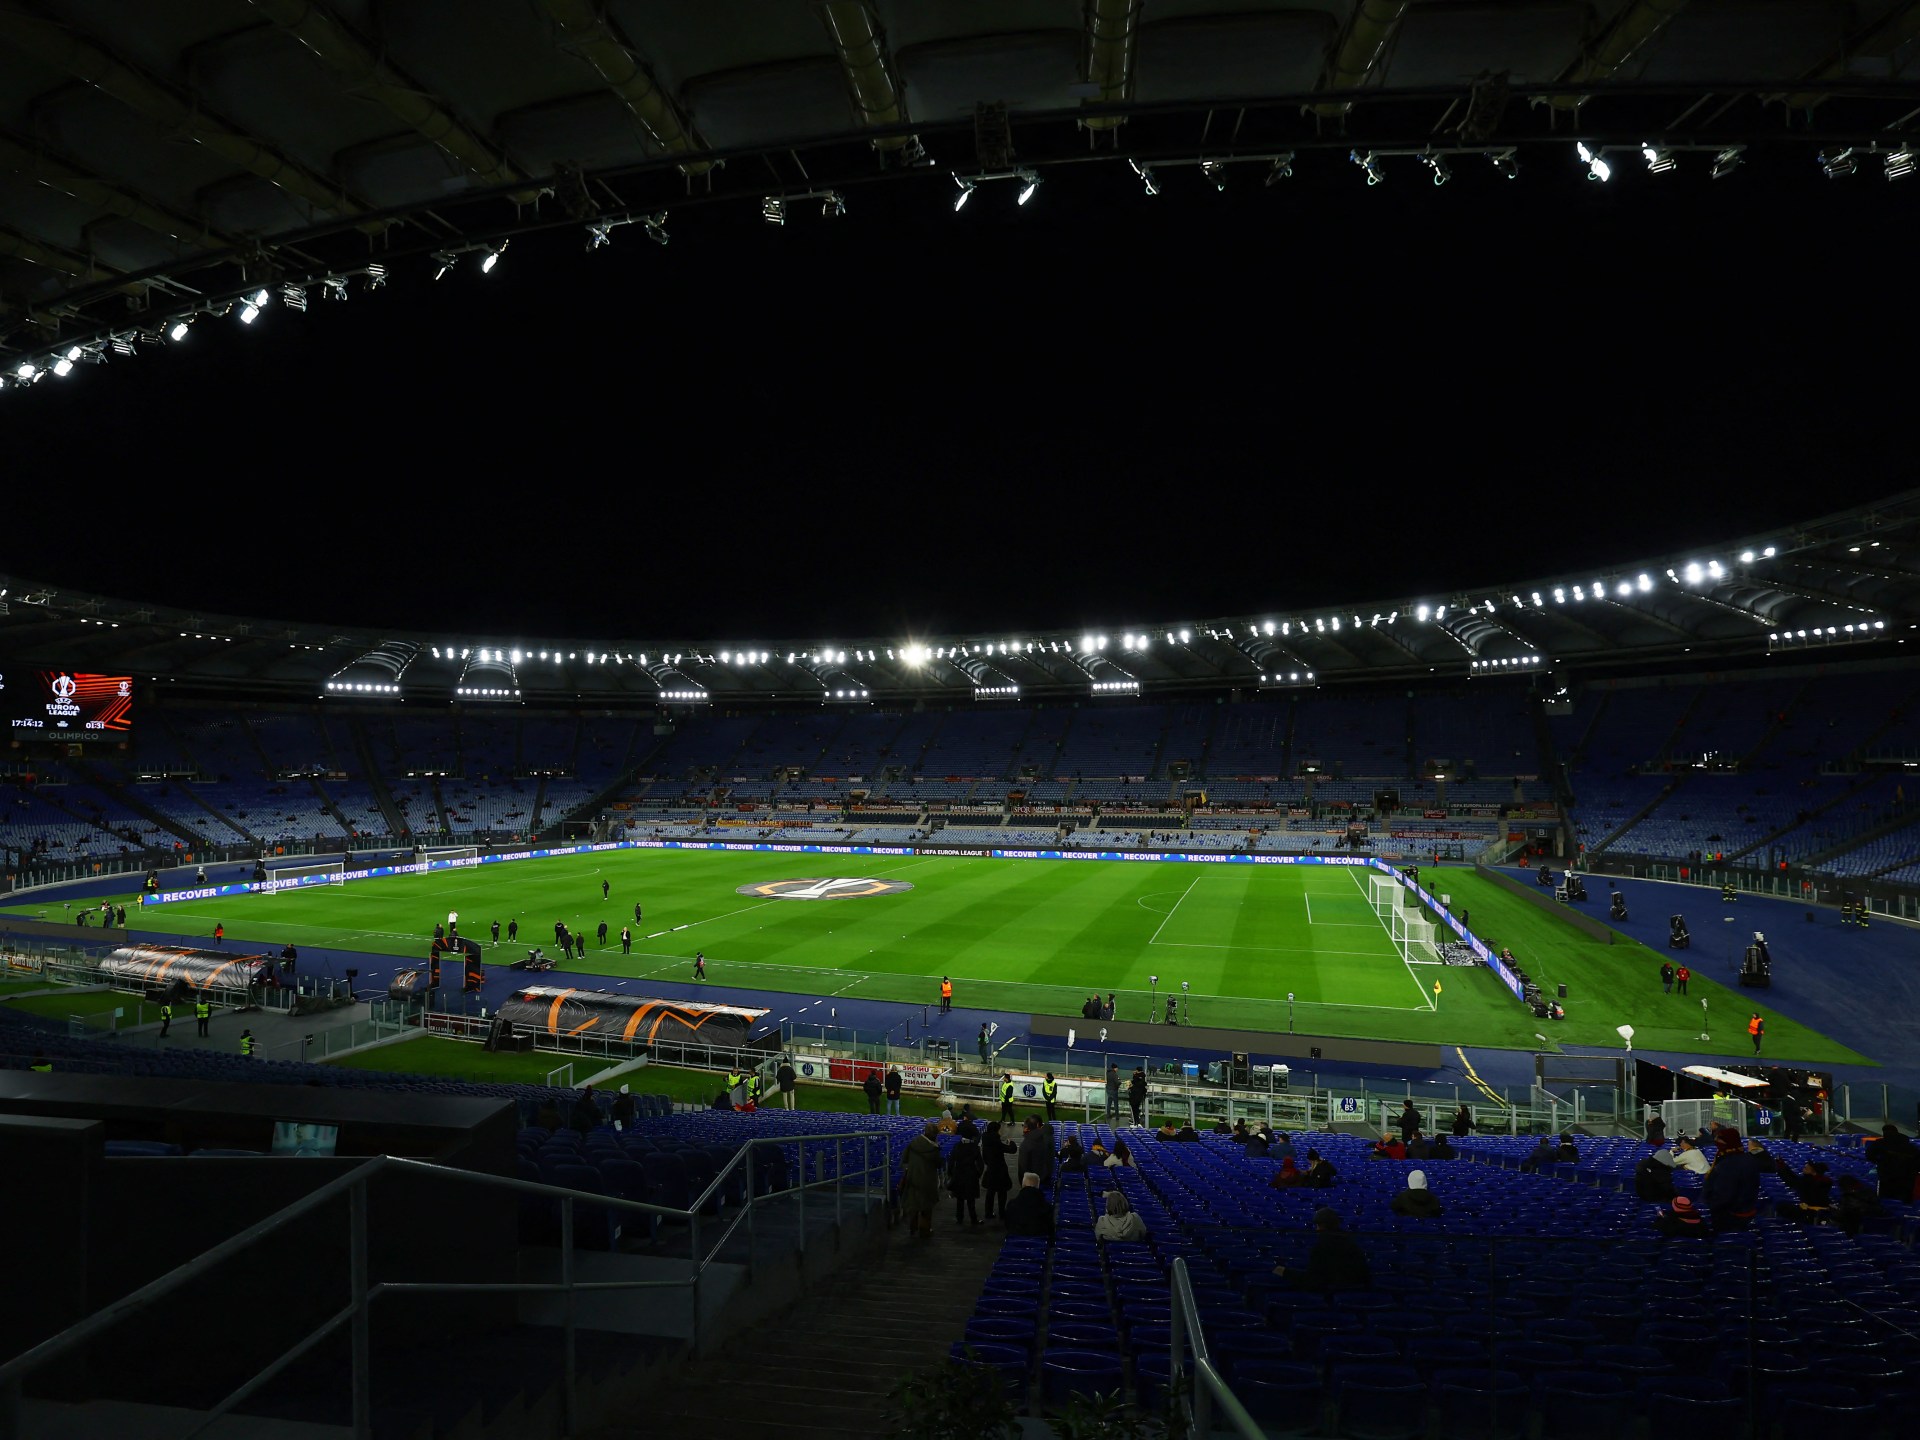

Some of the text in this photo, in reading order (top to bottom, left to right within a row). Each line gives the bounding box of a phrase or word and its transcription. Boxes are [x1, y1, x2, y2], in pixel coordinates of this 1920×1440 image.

[550, 847, 576, 855] RECOVER
[503, 852, 530, 861] RECOVER
[452, 857, 482, 867] RECOVER
[395, 863, 429, 873] RECOVER
[330, 870, 368, 882] RECOVER
[253, 878, 298, 891] RECOVER
[163, 888, 216, 902] RECOVER
